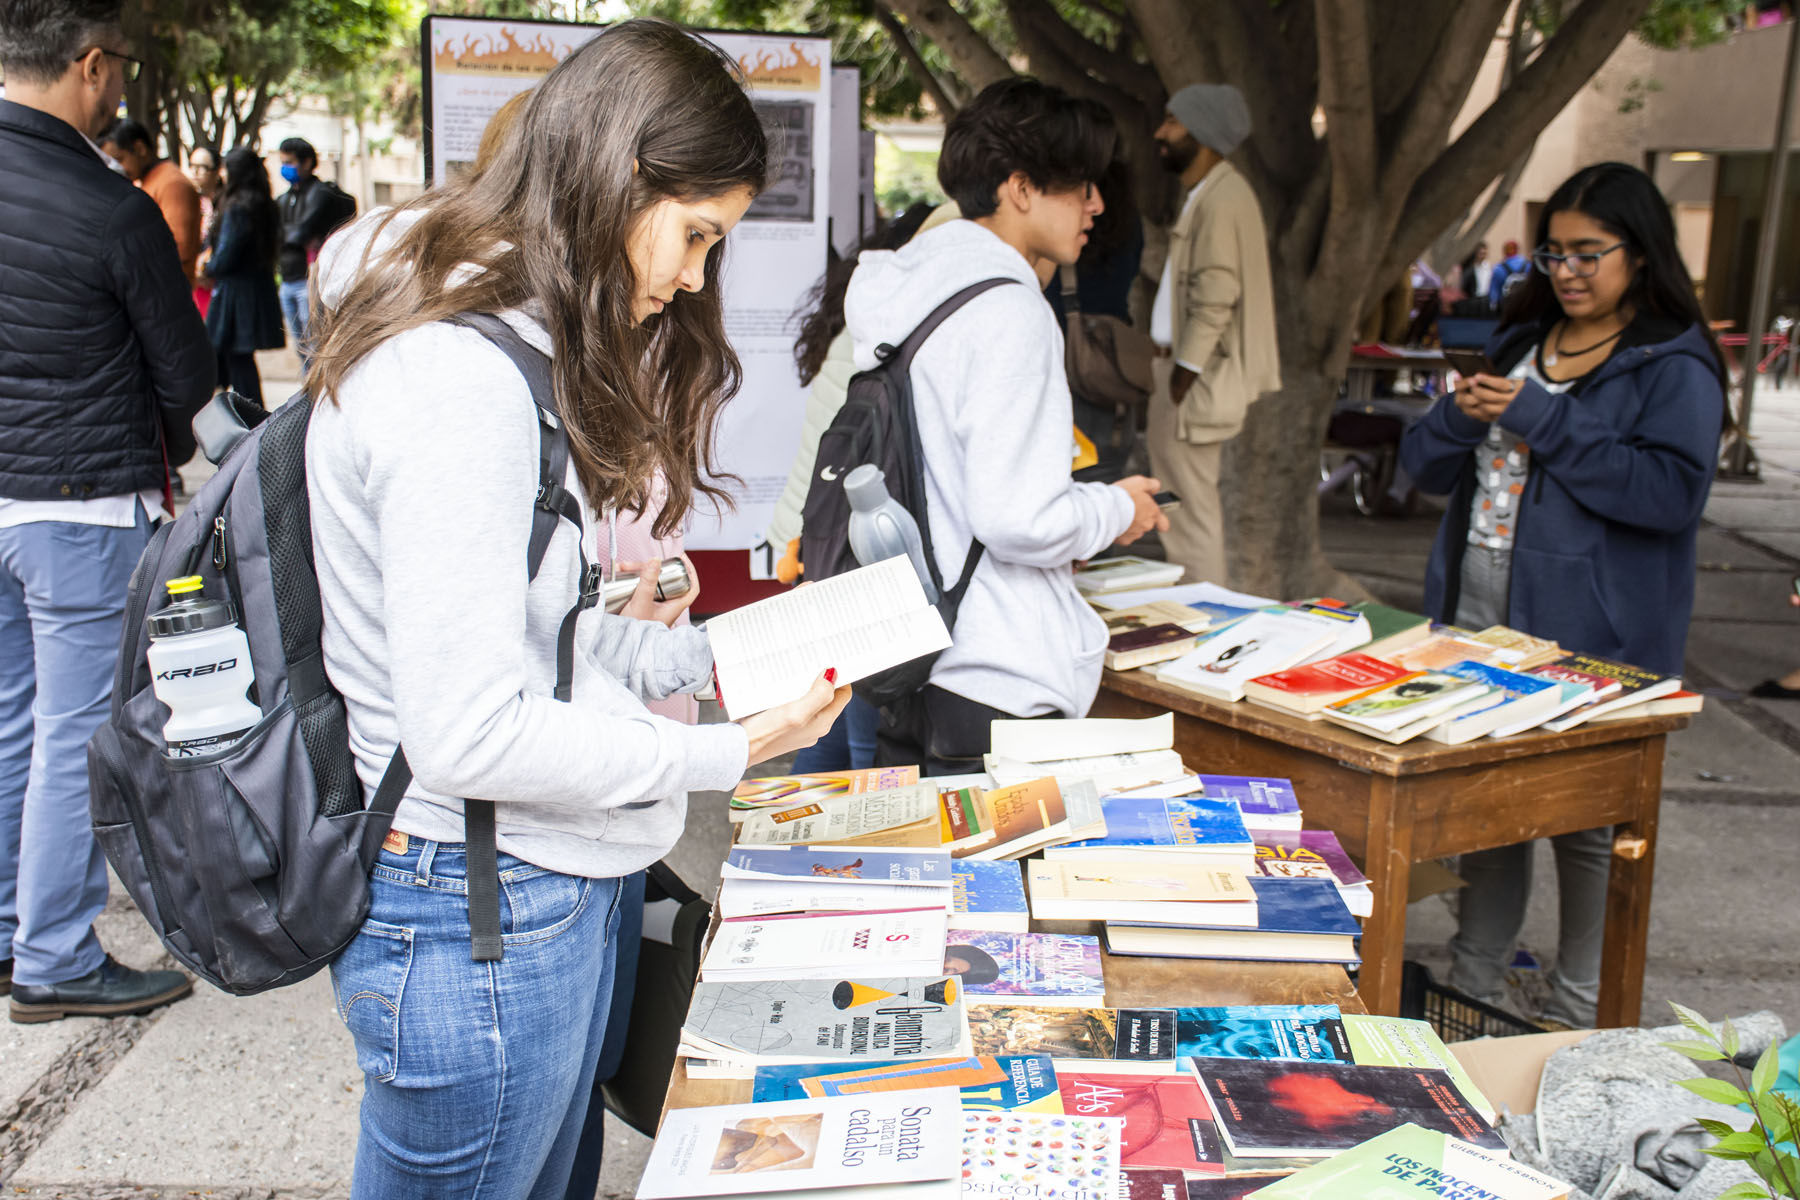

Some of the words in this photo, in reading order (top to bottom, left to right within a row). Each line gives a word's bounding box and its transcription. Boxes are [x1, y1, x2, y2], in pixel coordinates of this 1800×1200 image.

[850, 1016, 870, 1055] BIDIMENSIONAL
[875, 1006, 943, 1056] Geometría
[1150, 1018, 1160, 1031] TIRSO
[1290, 1019, 1301, 1032] DEL
[1149, 1039, 1159, 1054] MOLINA
[1293, 1033, 1311, 1060] ABOGADO
[1304, 1025, 1321, 1053] DIGNIDAD
[1025, 1058, 1042, 1077] GUÍA
[1009, 1059, 1030, 1105] REFERENCIA
[1030, 1077, 1044, 1089] DE
[841, 1109, 880, 1167] cadalso
[877, 1117, 897, 1140] para
[896, 1106, 932, 1162] Sonata
[878, 1143, 894, 1156] un
[1382, 1165, 1418, 1182] DE
[1384, 1152, 1423, 1170] LOS
[1421, 1166, 1507, 1200] INOCENT
[1450, 1143, 1494, 1162] GILBERT
[1498, 1162, 1556, 1190] CESBRON
[1119, 1171, 1134, 1200] cóm
